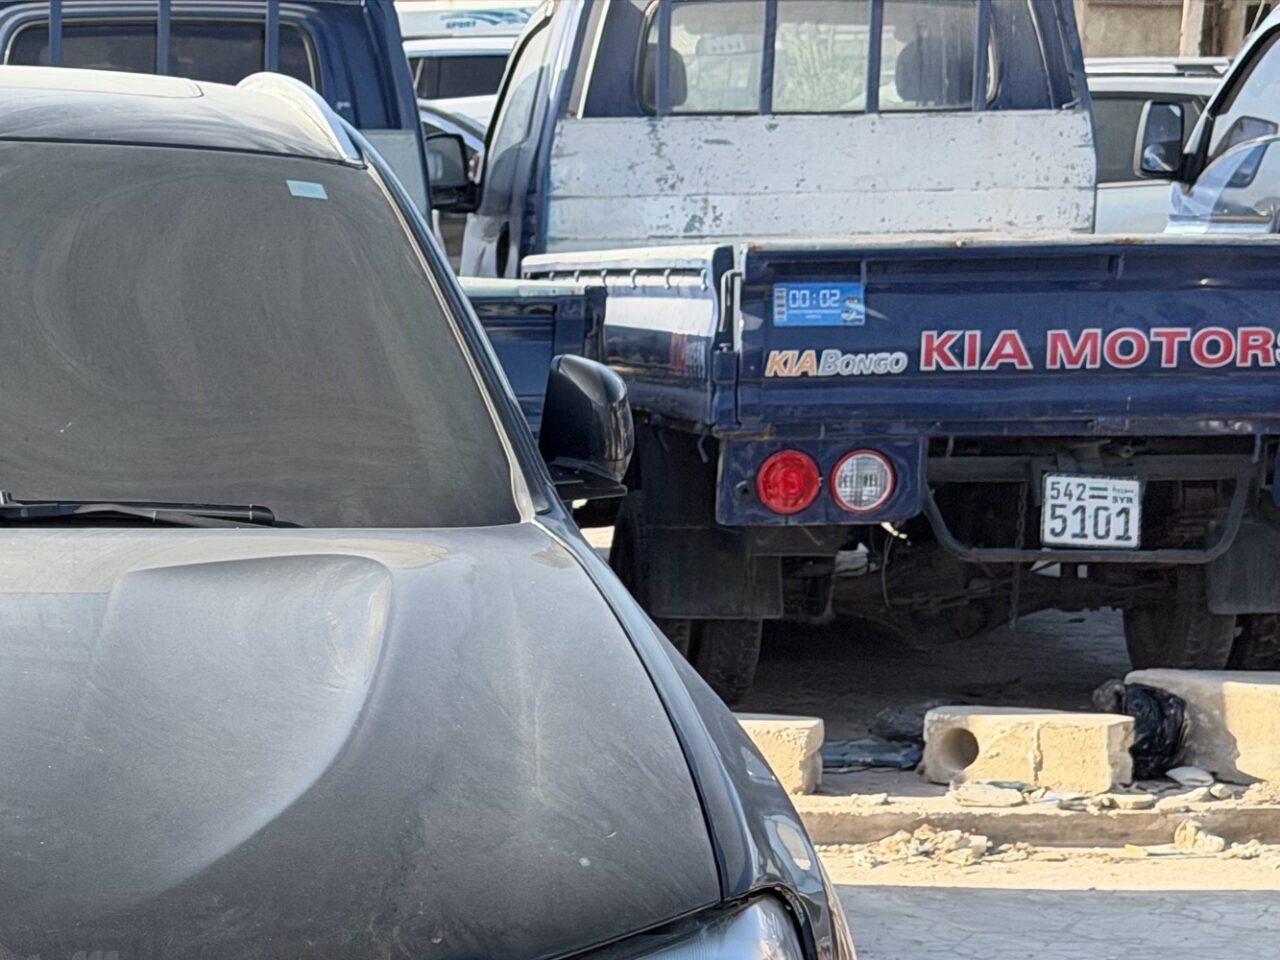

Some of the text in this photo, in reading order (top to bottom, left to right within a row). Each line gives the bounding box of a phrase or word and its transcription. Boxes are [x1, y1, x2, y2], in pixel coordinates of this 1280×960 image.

[787, 289, 841, 308] 00:02
[920, 326, 1280, 371] KIA MOTOR
[764, 349, 818, 377] KIA
[1050, 481, 1087, 501] 542
[1050, 504, 1133, 541] 5101
